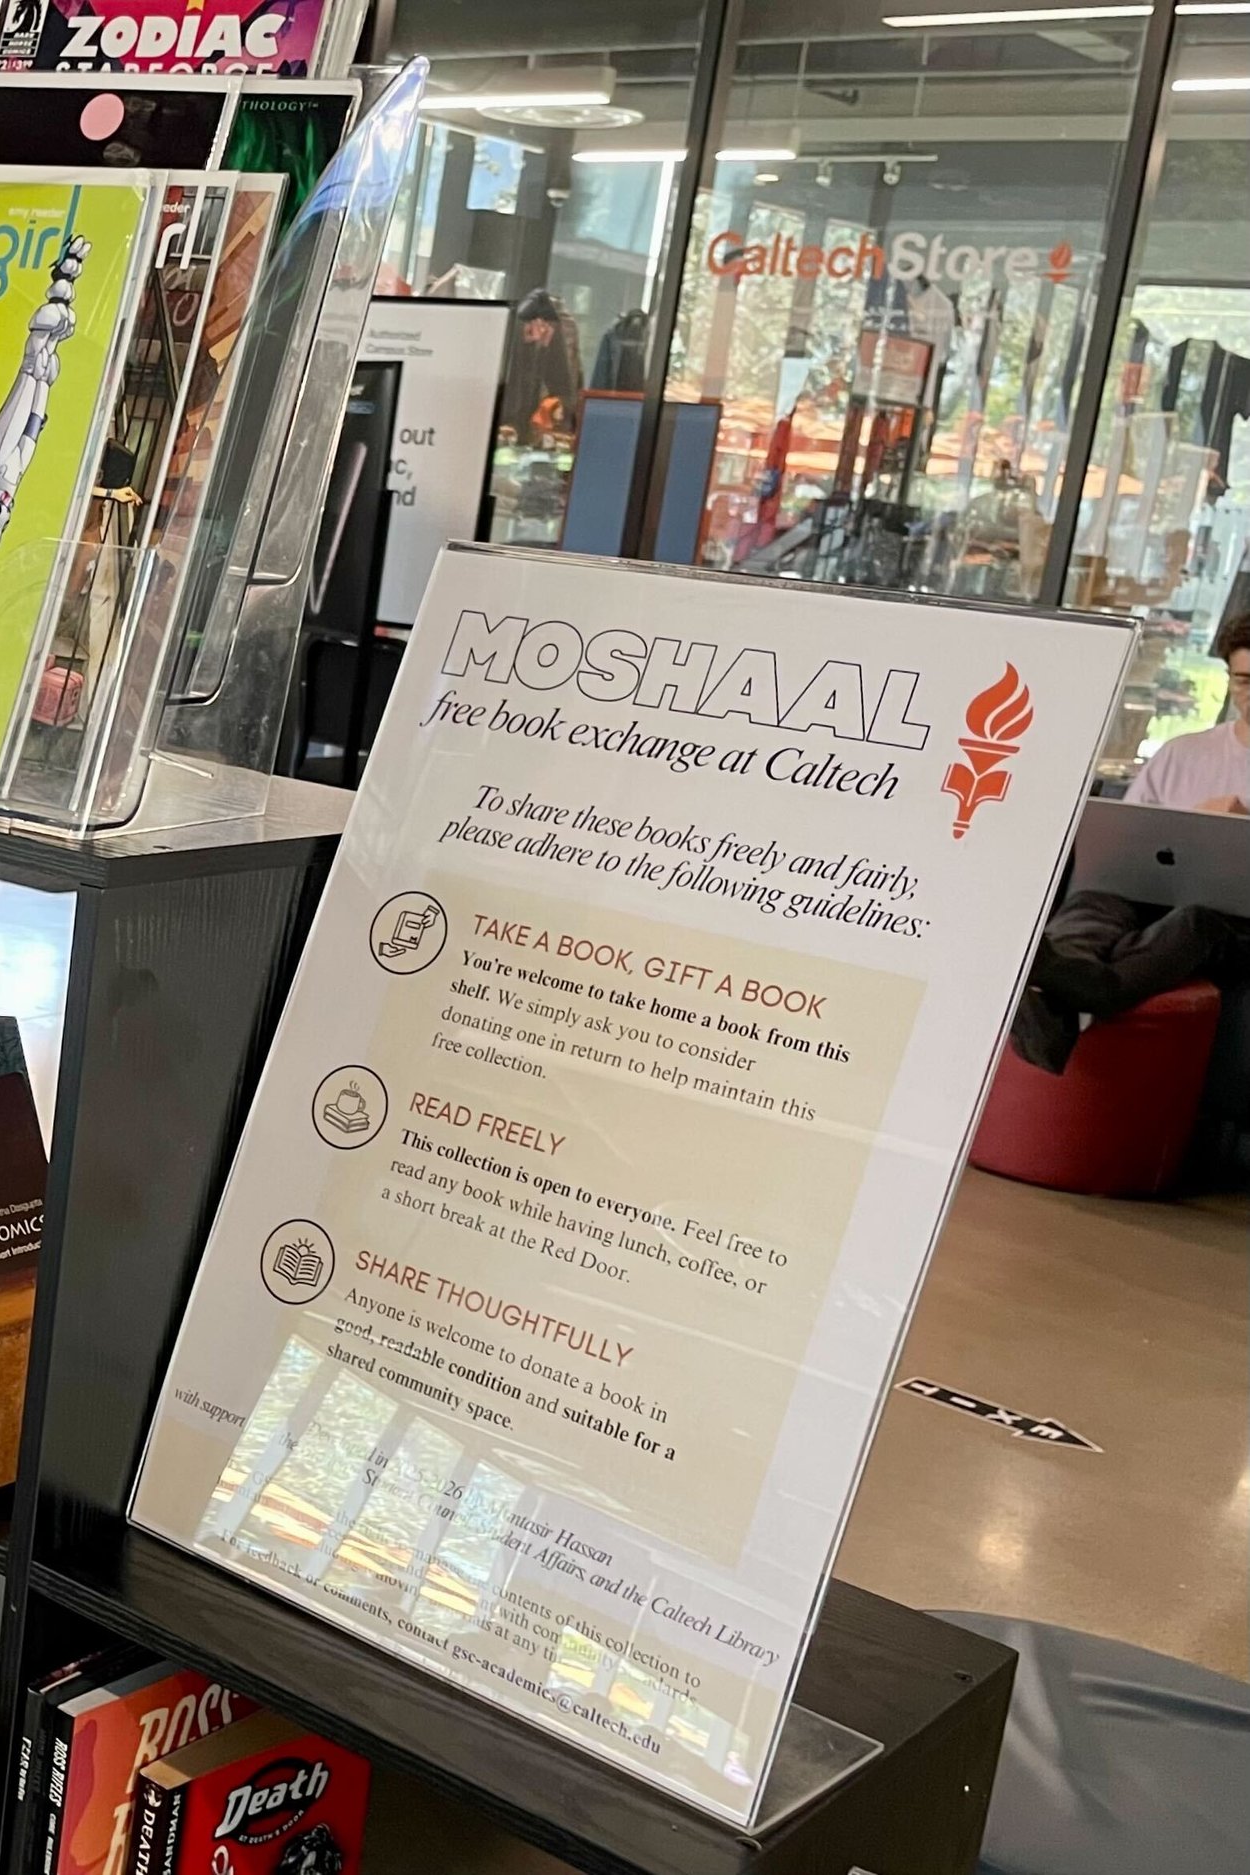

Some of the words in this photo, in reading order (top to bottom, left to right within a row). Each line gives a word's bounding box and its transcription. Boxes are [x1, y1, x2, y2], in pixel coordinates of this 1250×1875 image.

[59, 13, 286, 58] ZODIAC
[400, 427, 436, 446] out
[441, 609, 931, 751] MOSHAAL
[418, 690, 487, 728] free
[487, 698, 567, 742] book
[567, 720, 717, 774] exchange
[717, 748, 759, 775] at
[764, 746, 900, 801] Caltech
[437, 815, 514, 850] please
[513, 831, 594, 867] adhere
[594, 850, 622, 873] to
[624, 851, 666, 882] the
[656, 860, 786, 915] following
[781, 892, 931, 939] guidelines:
[474, 784, 505, 813] To
[504, 792, 570, 826] share
[571, 804, 634, 839] these
[633, 815, 712, 855] books
[702, 831, 788, 875] freely
[787, 853, 849, 882] and
[833, 857, 919, 901] fairly,
[463, 949, 514, 977] You're
[517, 967, 585, 996] welcome
[587, 984, 605, 1001] to
[608, 989, 647, 1011] take
[648, 997, 698, 1025] home
[700, 1015, 712, 1028] a
[716, 1014, 761, 1041] book
[765, 1027, 811, 1054] from
[815, 1040, 851, 1064] this
[473, 913, 533, 948] TAKE
[531, 930, 549, 953] A
[555, 934, 634, 976] BOOK,
[643, 956, 714, 991] GIFT
[713, 973, 733, 998] A
[740, 978, 828, 1020] BOOK
[431, 1031, 463, 1055] free
[464, 1045, 547, 1080] collection.
[440, 1004, 514, 1042] donating
[515, 1029, 547, 1048] one
[548, 1032, 566, 1054] in
[569, 1043, 623, 1069] return
[627, 1057, 646, 1075] to
[649, 1060, 689, 1090] help
[692, 1077, 775, 1111] maintain
[780, 1097, 817, 1122] this
[449, 978, 491, 1003] shelf.
[498, 988, 524, 1011] We
[525, 998, 582, 1029] simply
[583, 1015, 614, 1035] ask
[614, 1024, 651, 1044] you
[655, 1033, 675, 1050] to
[677, 1041, 757, 1072] consider
[408, 1091, 473, 1128] READ
[476, 1112, 567, 1157] FREELY
[380, 1187, 391, 1201] a
[393, 1189, 436, 1217] short
[439, 1202, 486, 1233] break
[487, 1224, 507, 1241] at
[509, 1228, 537, 1250] the
[539, 1236, 577, 1264] Red
[578, 1250, 631, 1284] Door.
[389, 1160, 427, 1182] read
[427, 1172, 460, 1195] any
[461, 1178, 505, 1208] book
[509, 1198, 553, 1224] while
[554, 1209, 615, 1249] having
[617, 1229, 672, 1266] lunch,
[677, 1255, 738, 1288] coffee,
[744, 1277, 768, 1295] or
[401, 1127, 434, 1153] This
[436, 1145, 512, 1179] collection
[514, 1165, 530, 1184] is
[532, 1175, 572, 1198] open
[575, 1187, 593, 1205] to
[595, 1196, 676, 1233] everyone.
[682, 1218, 723, 1247] Feel
[726, 1233, 764, 1260] free
[767, 1249, 788, 1267] to
[343, 1287, 406, 1323] Anyone
[407, 1308, 423, 1329] is
[426, 1320, 496, 1357] welcome
[498, 1347, 517, 1365] to
[519, 1354, 580, 1390] donate
[582, 1381, 594, 1396] a
[598, 1381, 646, 1416] book
[648, 1401, 668, 1425] in
[354, 1249, 432, 1295] SHARE
[436, 1276, 635, 1368] THOUGHTFULLY
[325, 1342, 377, 1374] shared
[377, 1365, 461, 1412] community
[465, 1401, 514, 1431] space.
[333, 1317, 375, 1345] good,
[379, 1334, 446, 1370] readable
[447, 1362, 522, 1401] condition
[524, 1392, 560, 1415] and
[561, 1406, 630, 1443] suitable
[633, 1430, 662, 1455] for
[663, 1447, 676, 1462] a
[553, 1528, 613, 1567] Hassan
[396, 1618, 450, 1651] contact
[650, 1596, 713, 1637] Caltech
[713, 1623, 781, 1668] Library
[214, 1762, 330, 1838] Death
